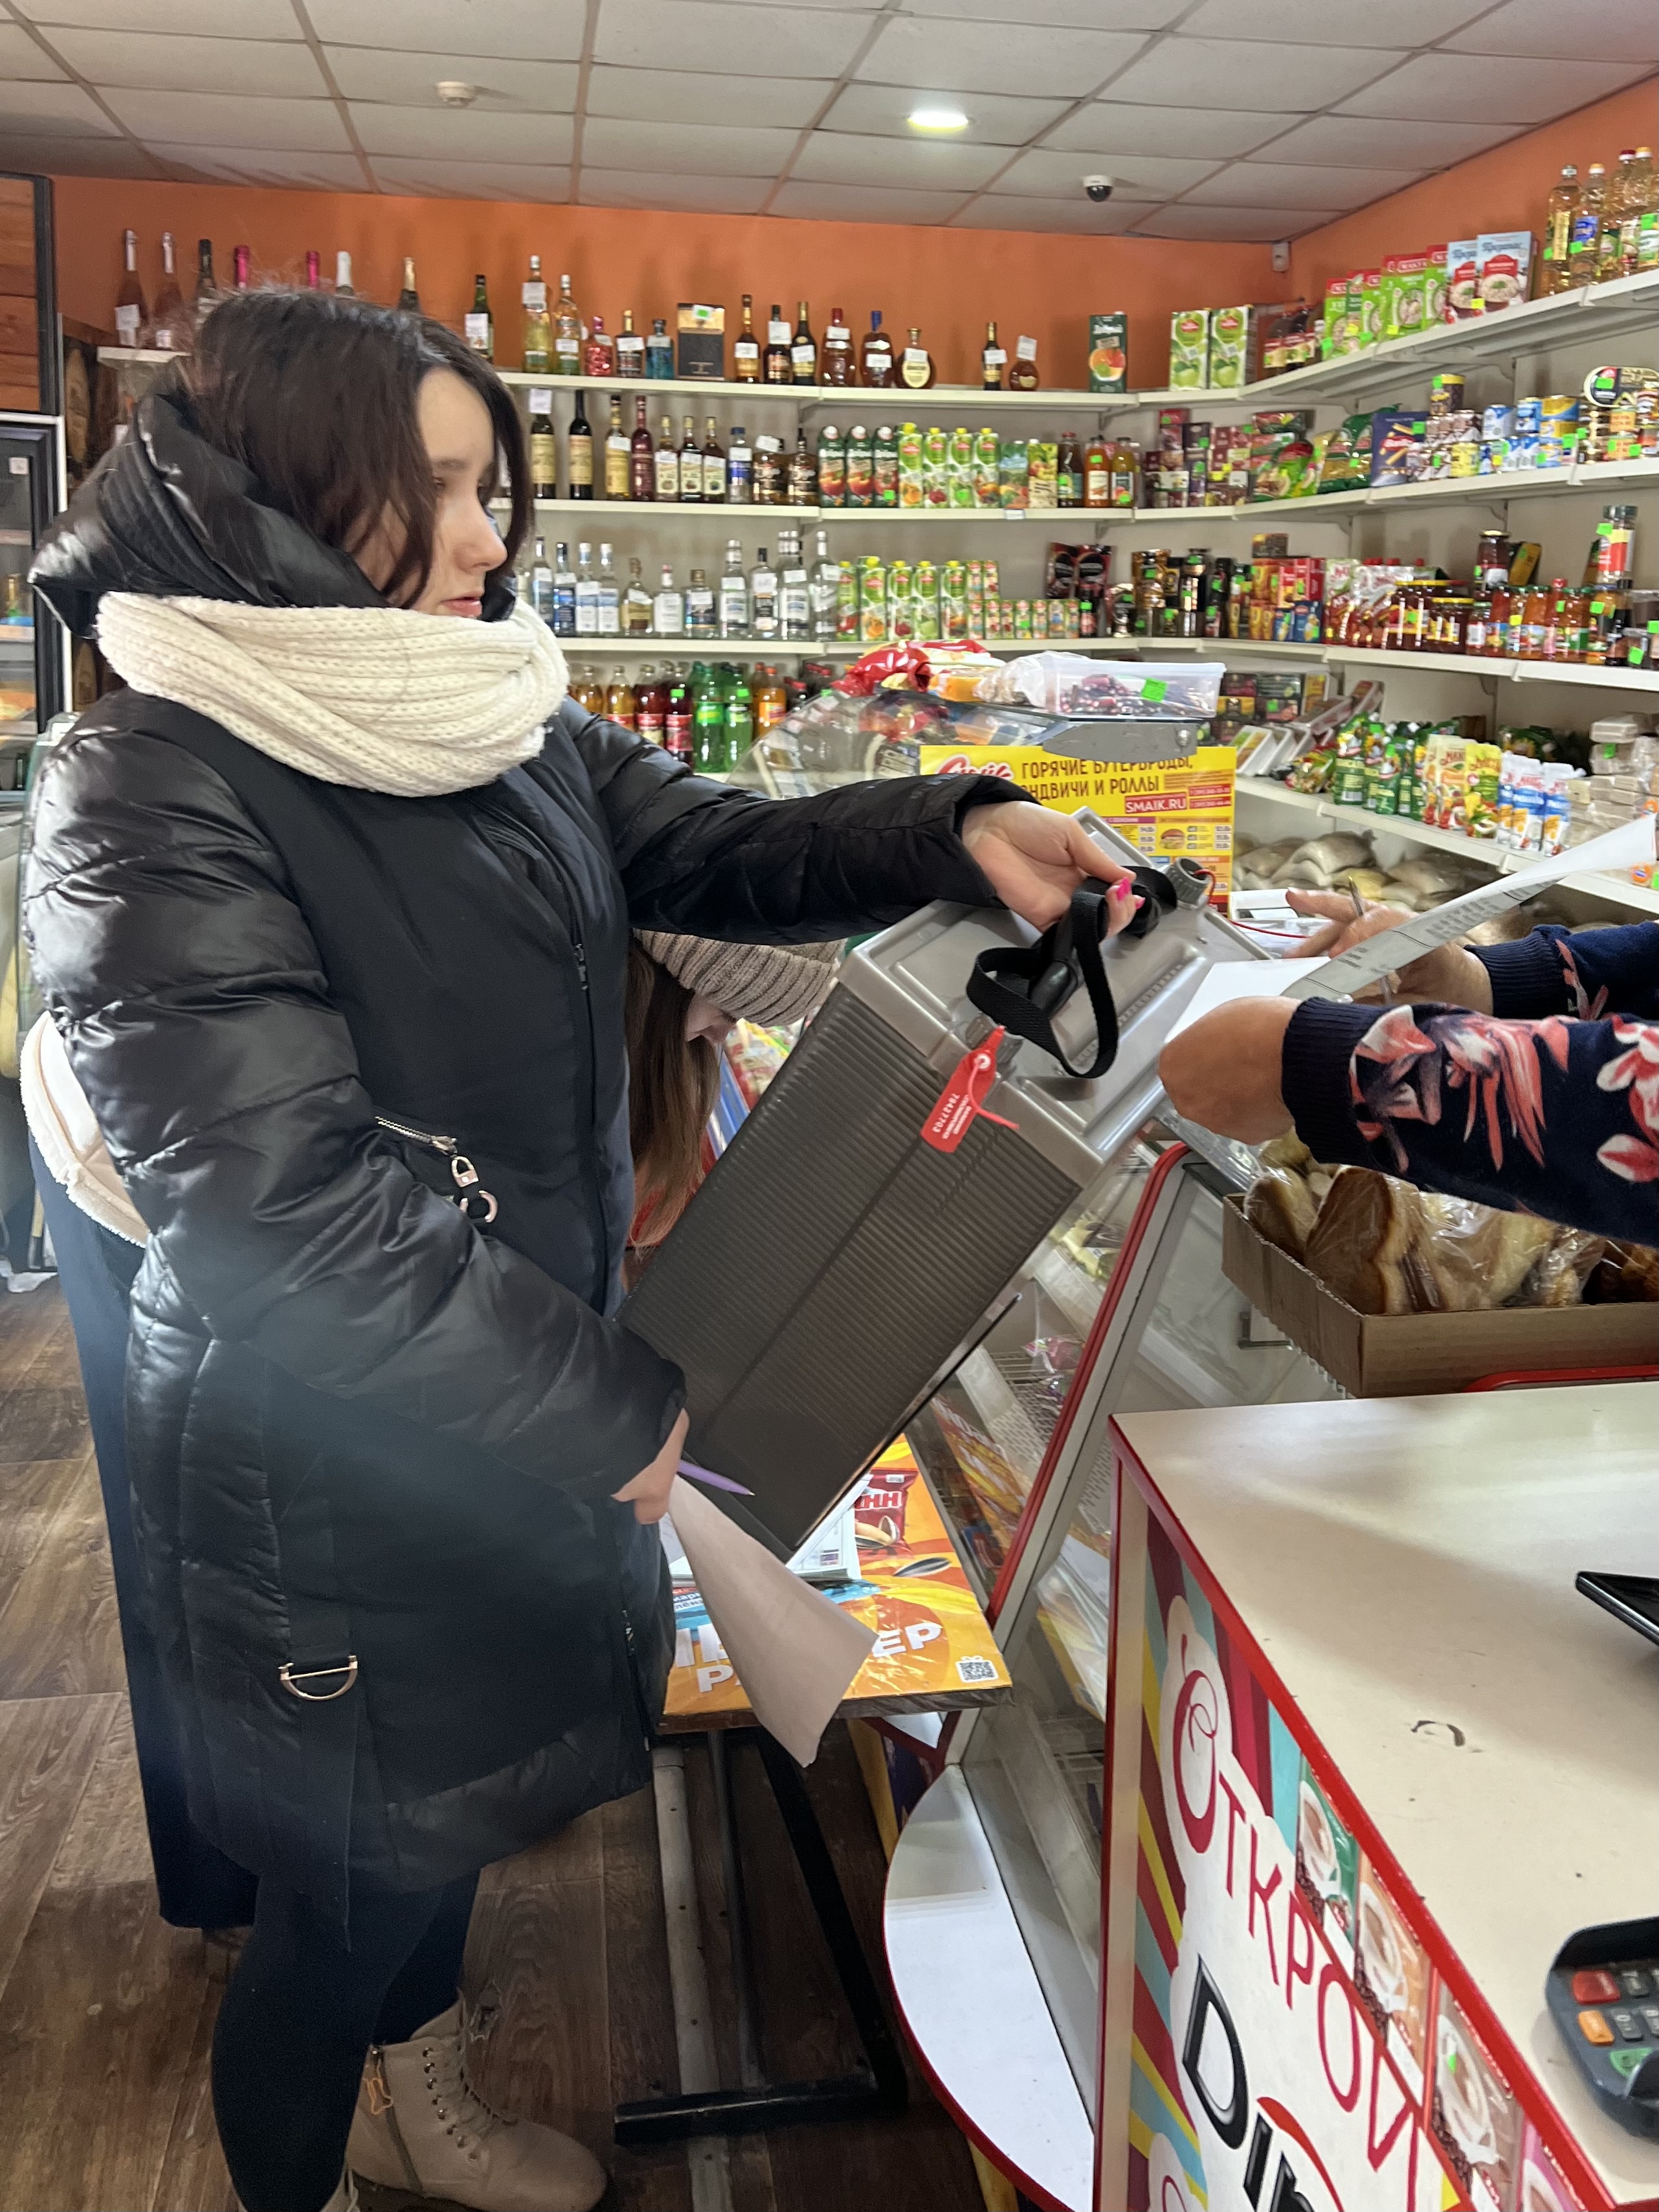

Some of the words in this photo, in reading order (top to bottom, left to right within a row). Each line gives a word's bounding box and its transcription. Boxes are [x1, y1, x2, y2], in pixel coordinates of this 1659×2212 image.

[1022, 759, 1088, 779] ГОРЯЧИЕ
[1095, 779, 1104, 796] И
[1109, 776, 1159, 794] РОЛЛЫ
[1126, 798, 1186, 813] SMAIK.RU
